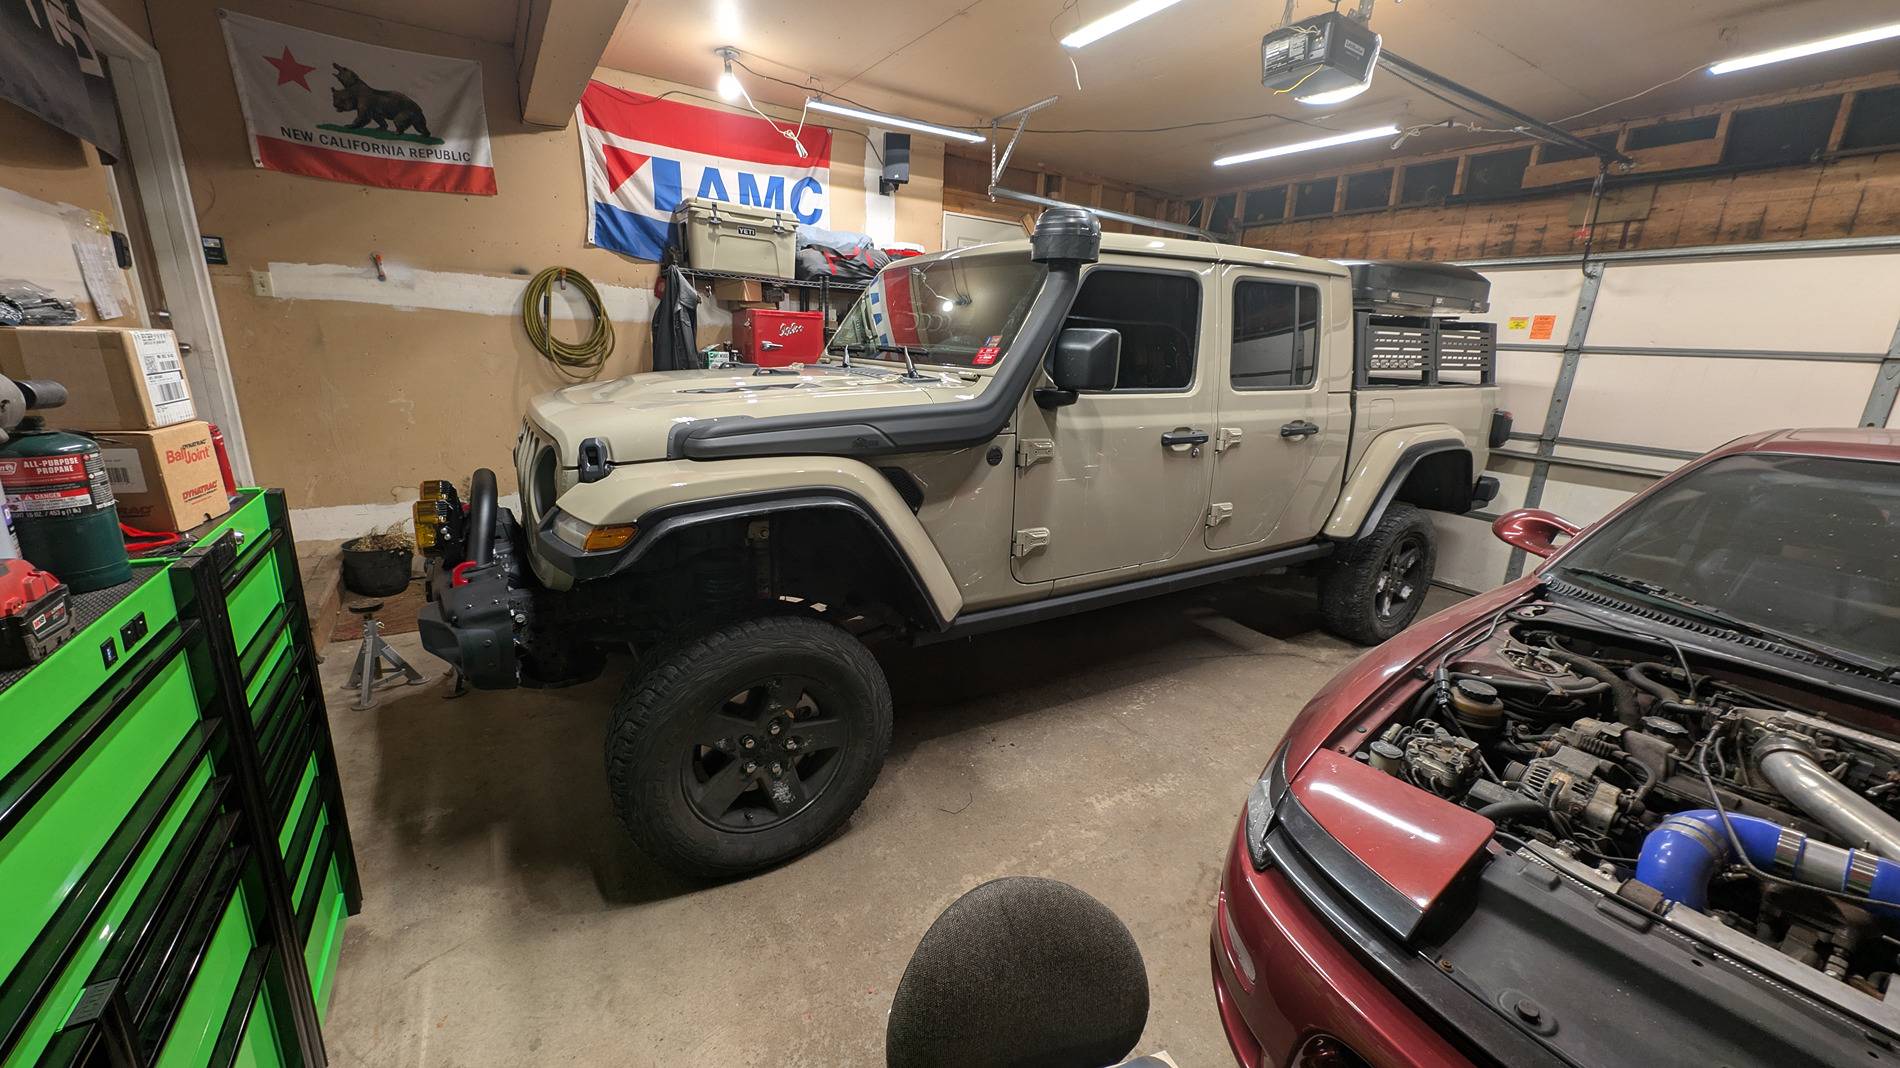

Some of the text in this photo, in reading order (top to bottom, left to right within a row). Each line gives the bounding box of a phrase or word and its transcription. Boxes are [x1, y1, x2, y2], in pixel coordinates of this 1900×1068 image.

[281, 126, 471, 162] NEW CALIFORNIA REPUBLIC
[697, 166, 823, 225] AMC
[738, 227, 755, 236] YETI
[24, 457, 79, 469] ALL-PURPOSE
[166, 447, 210, 464] Ball Joint
[37, 465, 74, 475] PROPANE
[182, 480, 217, 500] DYNATRAC
